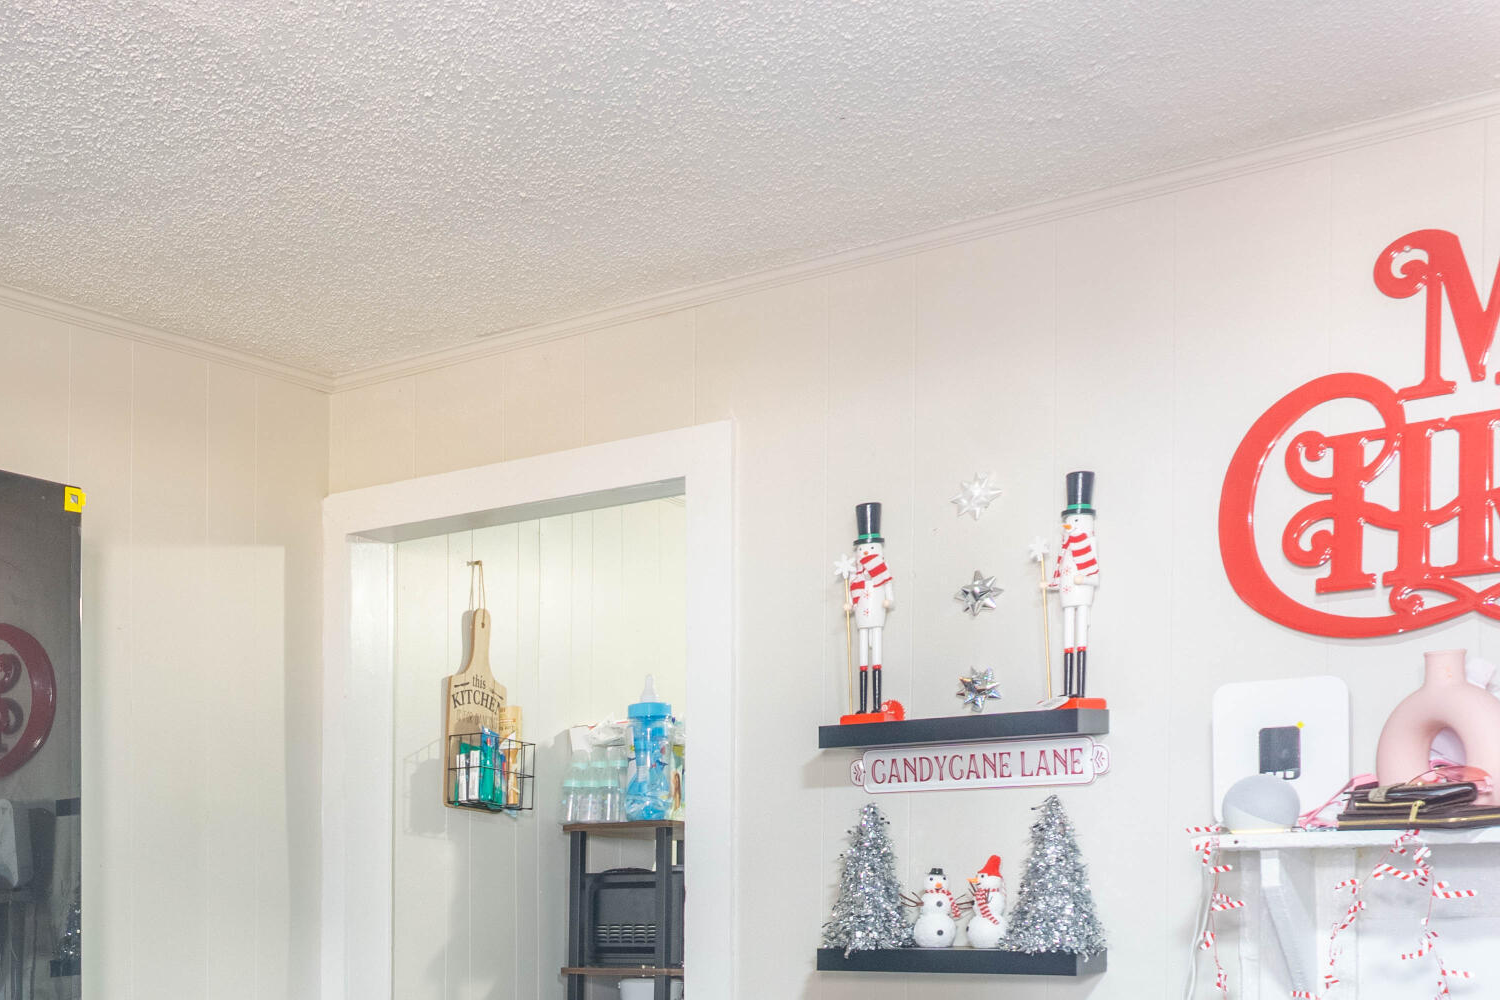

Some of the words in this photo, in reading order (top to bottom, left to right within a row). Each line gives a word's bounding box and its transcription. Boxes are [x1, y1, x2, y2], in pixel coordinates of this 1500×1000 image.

[473, 674, 486, 689] this
[871, 752, 1012, 785] CANDYCANE
[1020, 748, 1084, 776] LANE
